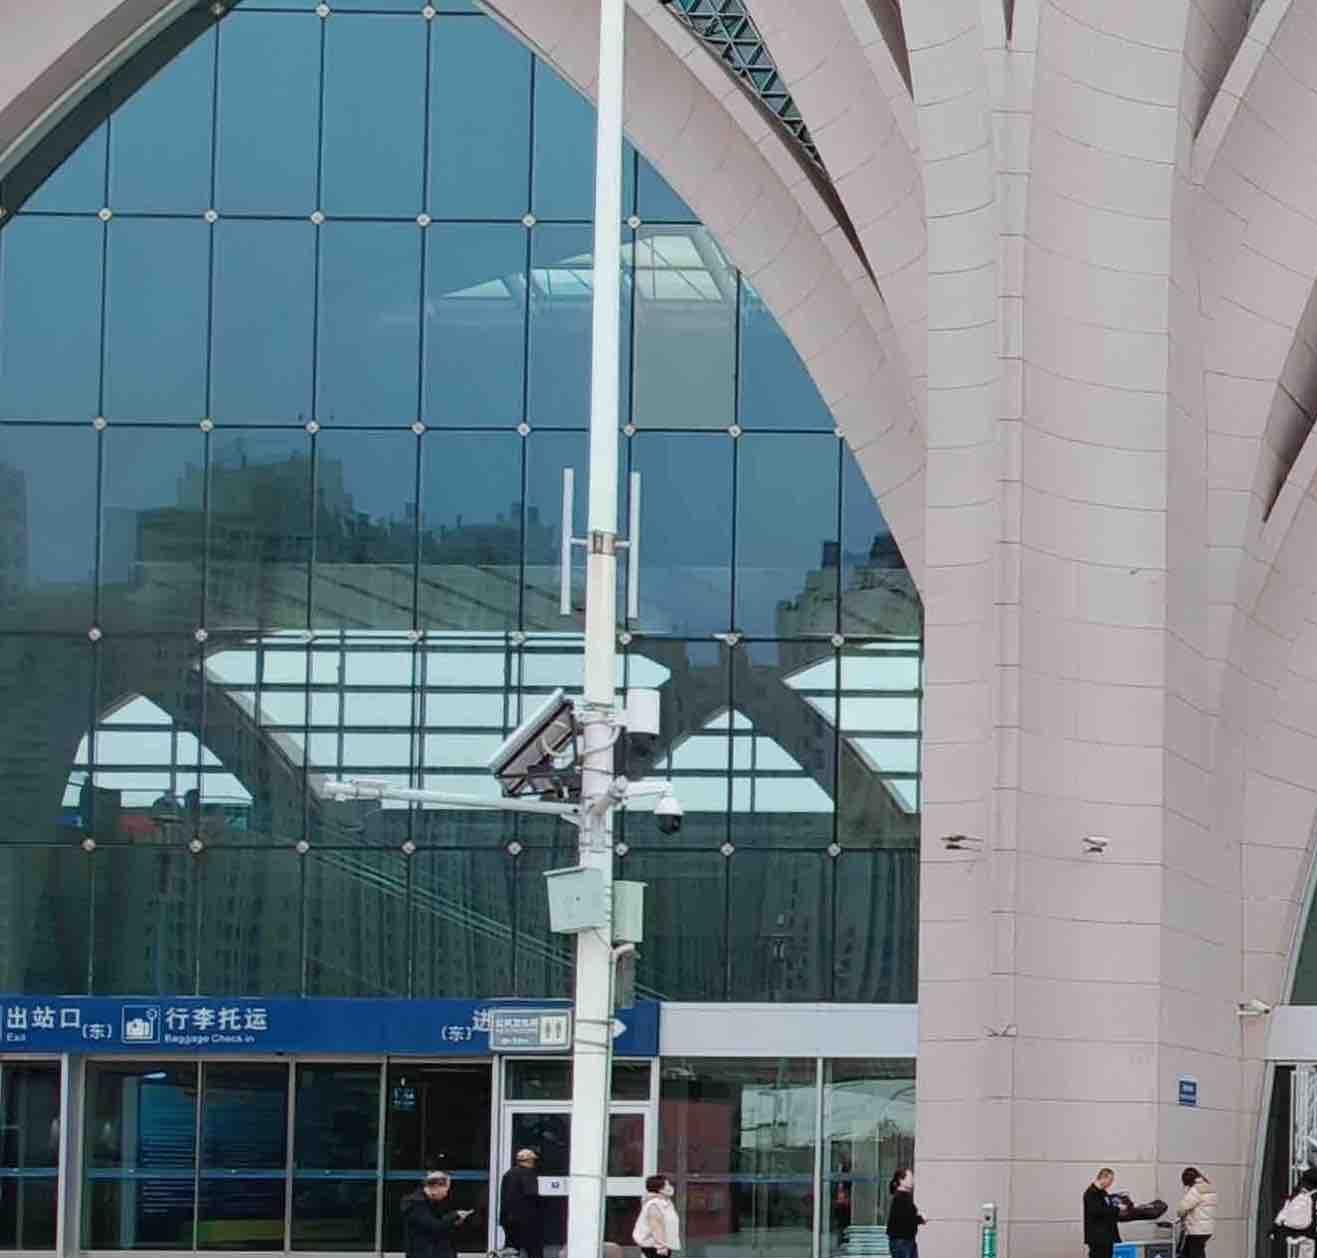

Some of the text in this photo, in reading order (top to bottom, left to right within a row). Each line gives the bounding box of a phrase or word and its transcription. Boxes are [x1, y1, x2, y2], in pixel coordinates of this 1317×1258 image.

[6, 1005, 82, 1029] 出站口
[165, 1007, 269, 1031] 行李托运
